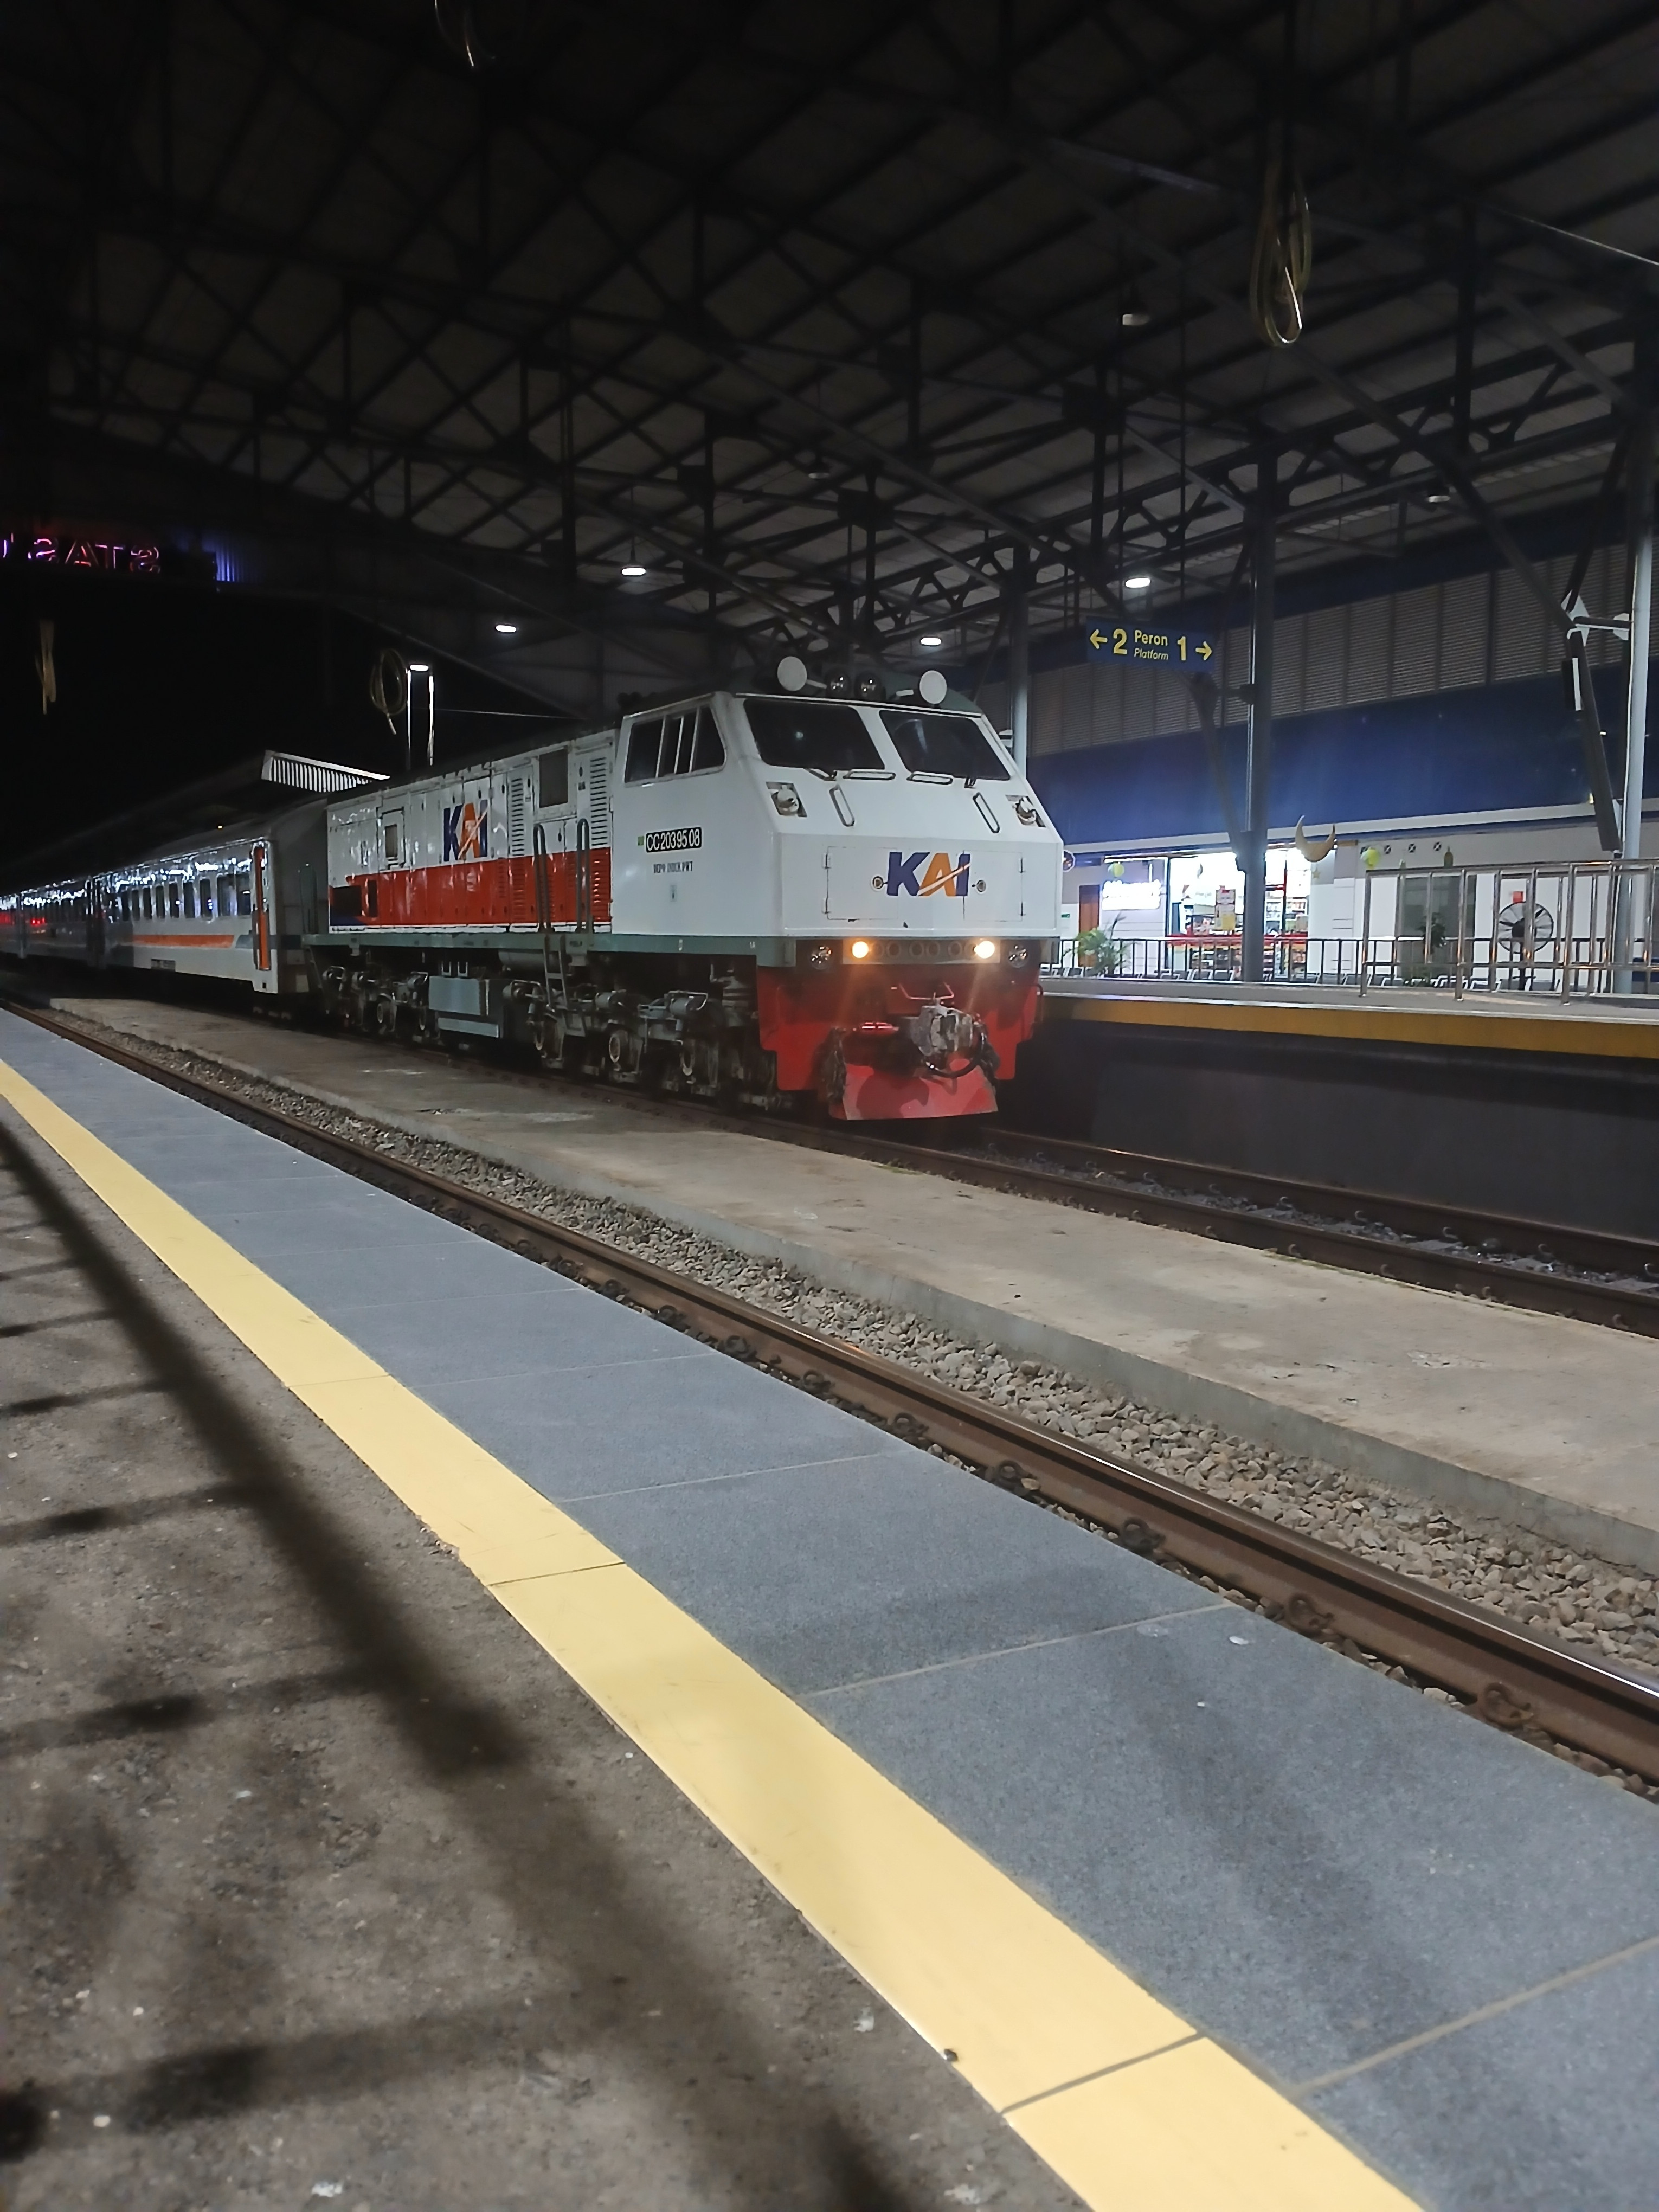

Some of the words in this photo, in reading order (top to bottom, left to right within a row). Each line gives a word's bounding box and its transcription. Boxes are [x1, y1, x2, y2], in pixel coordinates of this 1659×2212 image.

[1113, 628, 1127, 654] 2
[1135, 629, 1168, 646] Peron
[1177, 636, 1186, 661] 1
[1134, 647, 1168, 660] Platform
[444, 799, 487, 861] KAI
[886, 852, 970, 896] KAI
